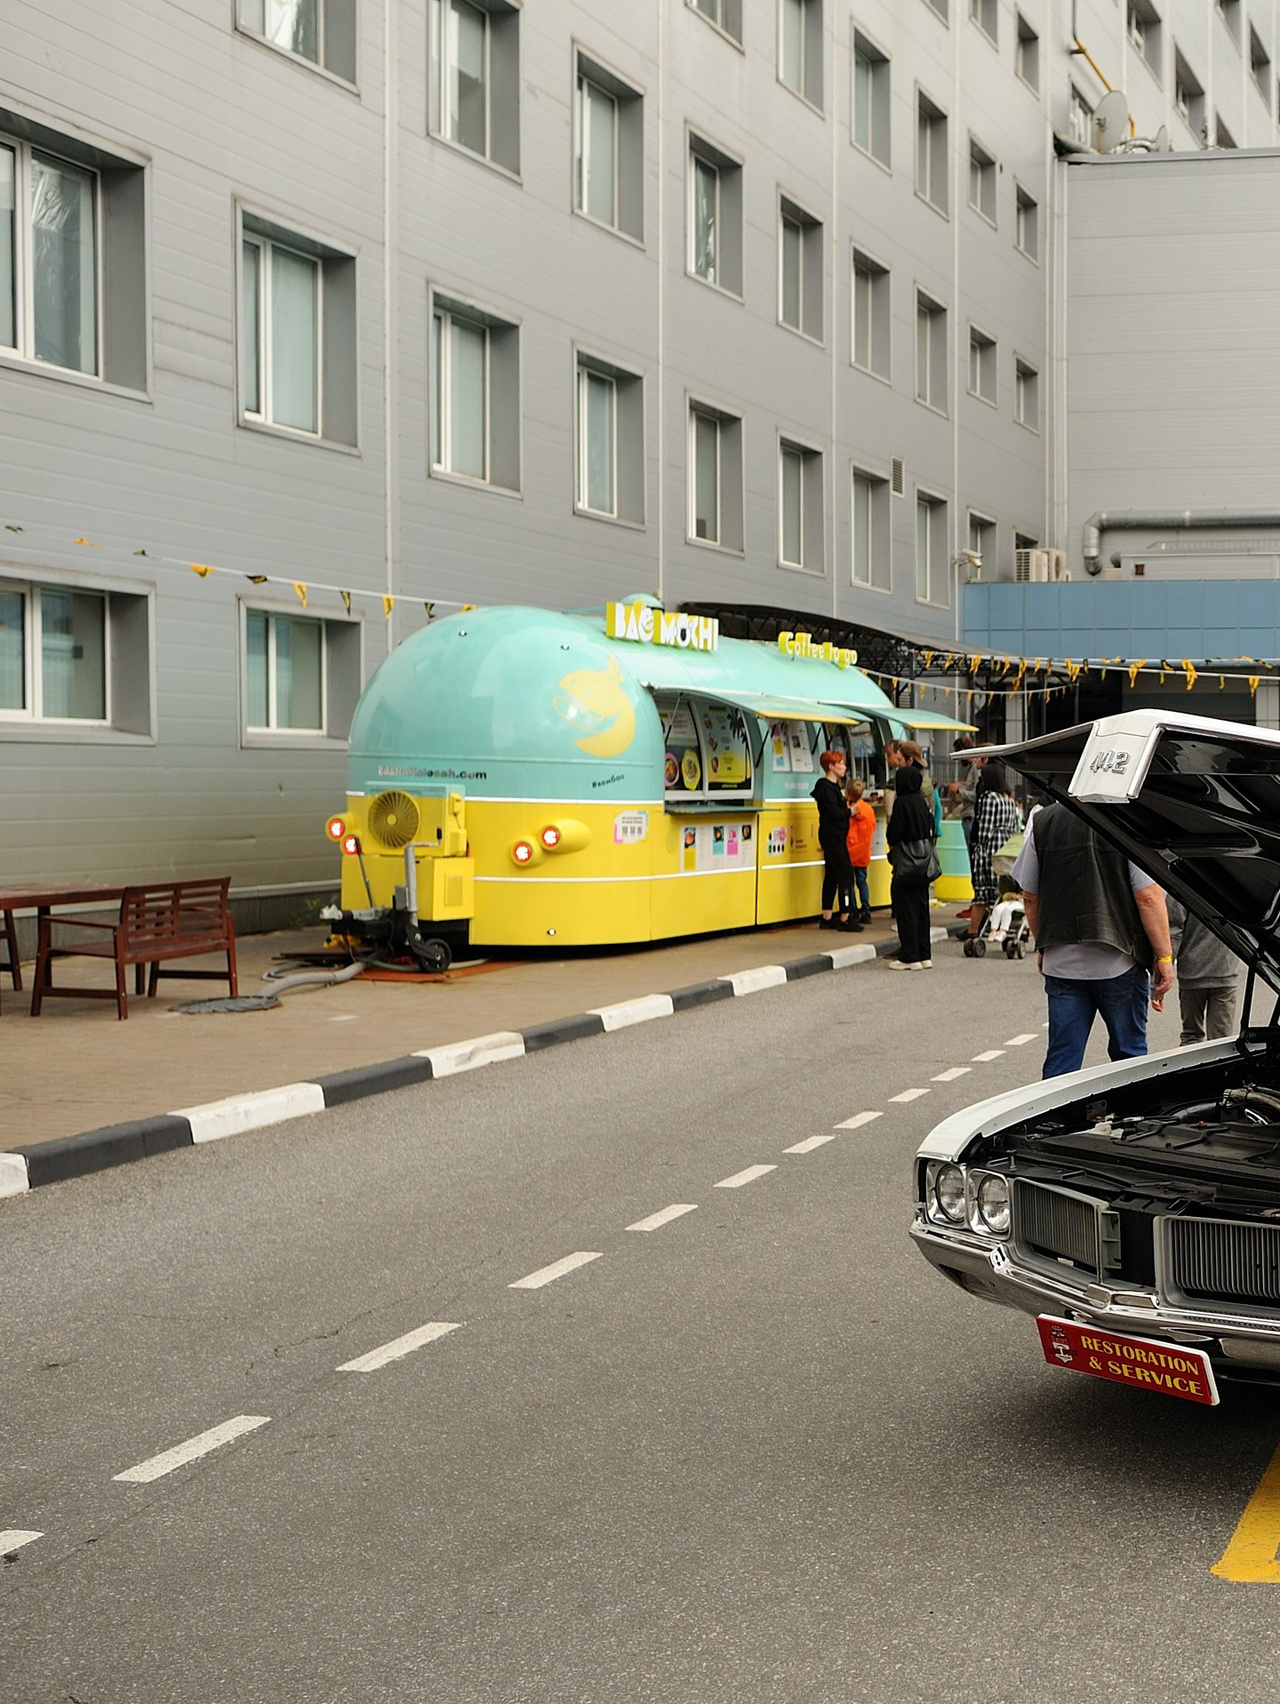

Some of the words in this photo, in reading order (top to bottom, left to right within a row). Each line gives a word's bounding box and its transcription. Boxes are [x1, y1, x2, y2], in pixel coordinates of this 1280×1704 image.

[658, 611, 719, 651] MOCHI
[780, 631, 824, 659] Coffee
[841, 649, 858, 669] go
[1081, 1335, 1199, 1375] RESTORATION
[1089, 1356, 1103, 1371] &
[1108, 1360, 1204, 1397] SERVICE
